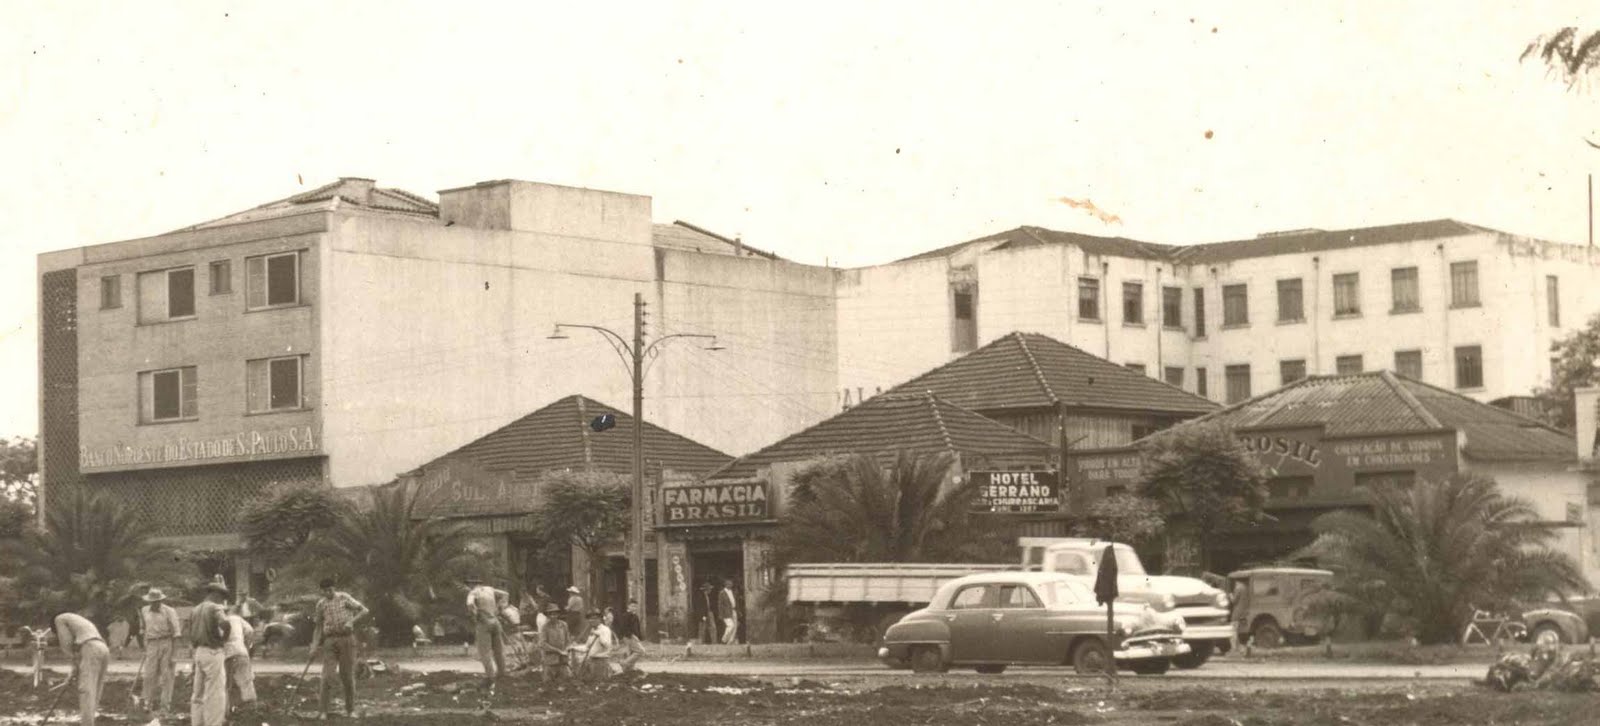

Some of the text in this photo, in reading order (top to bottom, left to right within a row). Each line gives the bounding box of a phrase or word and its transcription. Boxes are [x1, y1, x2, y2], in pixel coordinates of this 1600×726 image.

[179, 436, 220, 460] ESTADO
[236, 431, 250, 456] S.
[251, 430, 287, 455] PAULO
[990, 472, 1039, 485] HOTEL
[665, 485, 766, 506] FARMÁCIA
[670, 503, 762, 520] BRASIL
